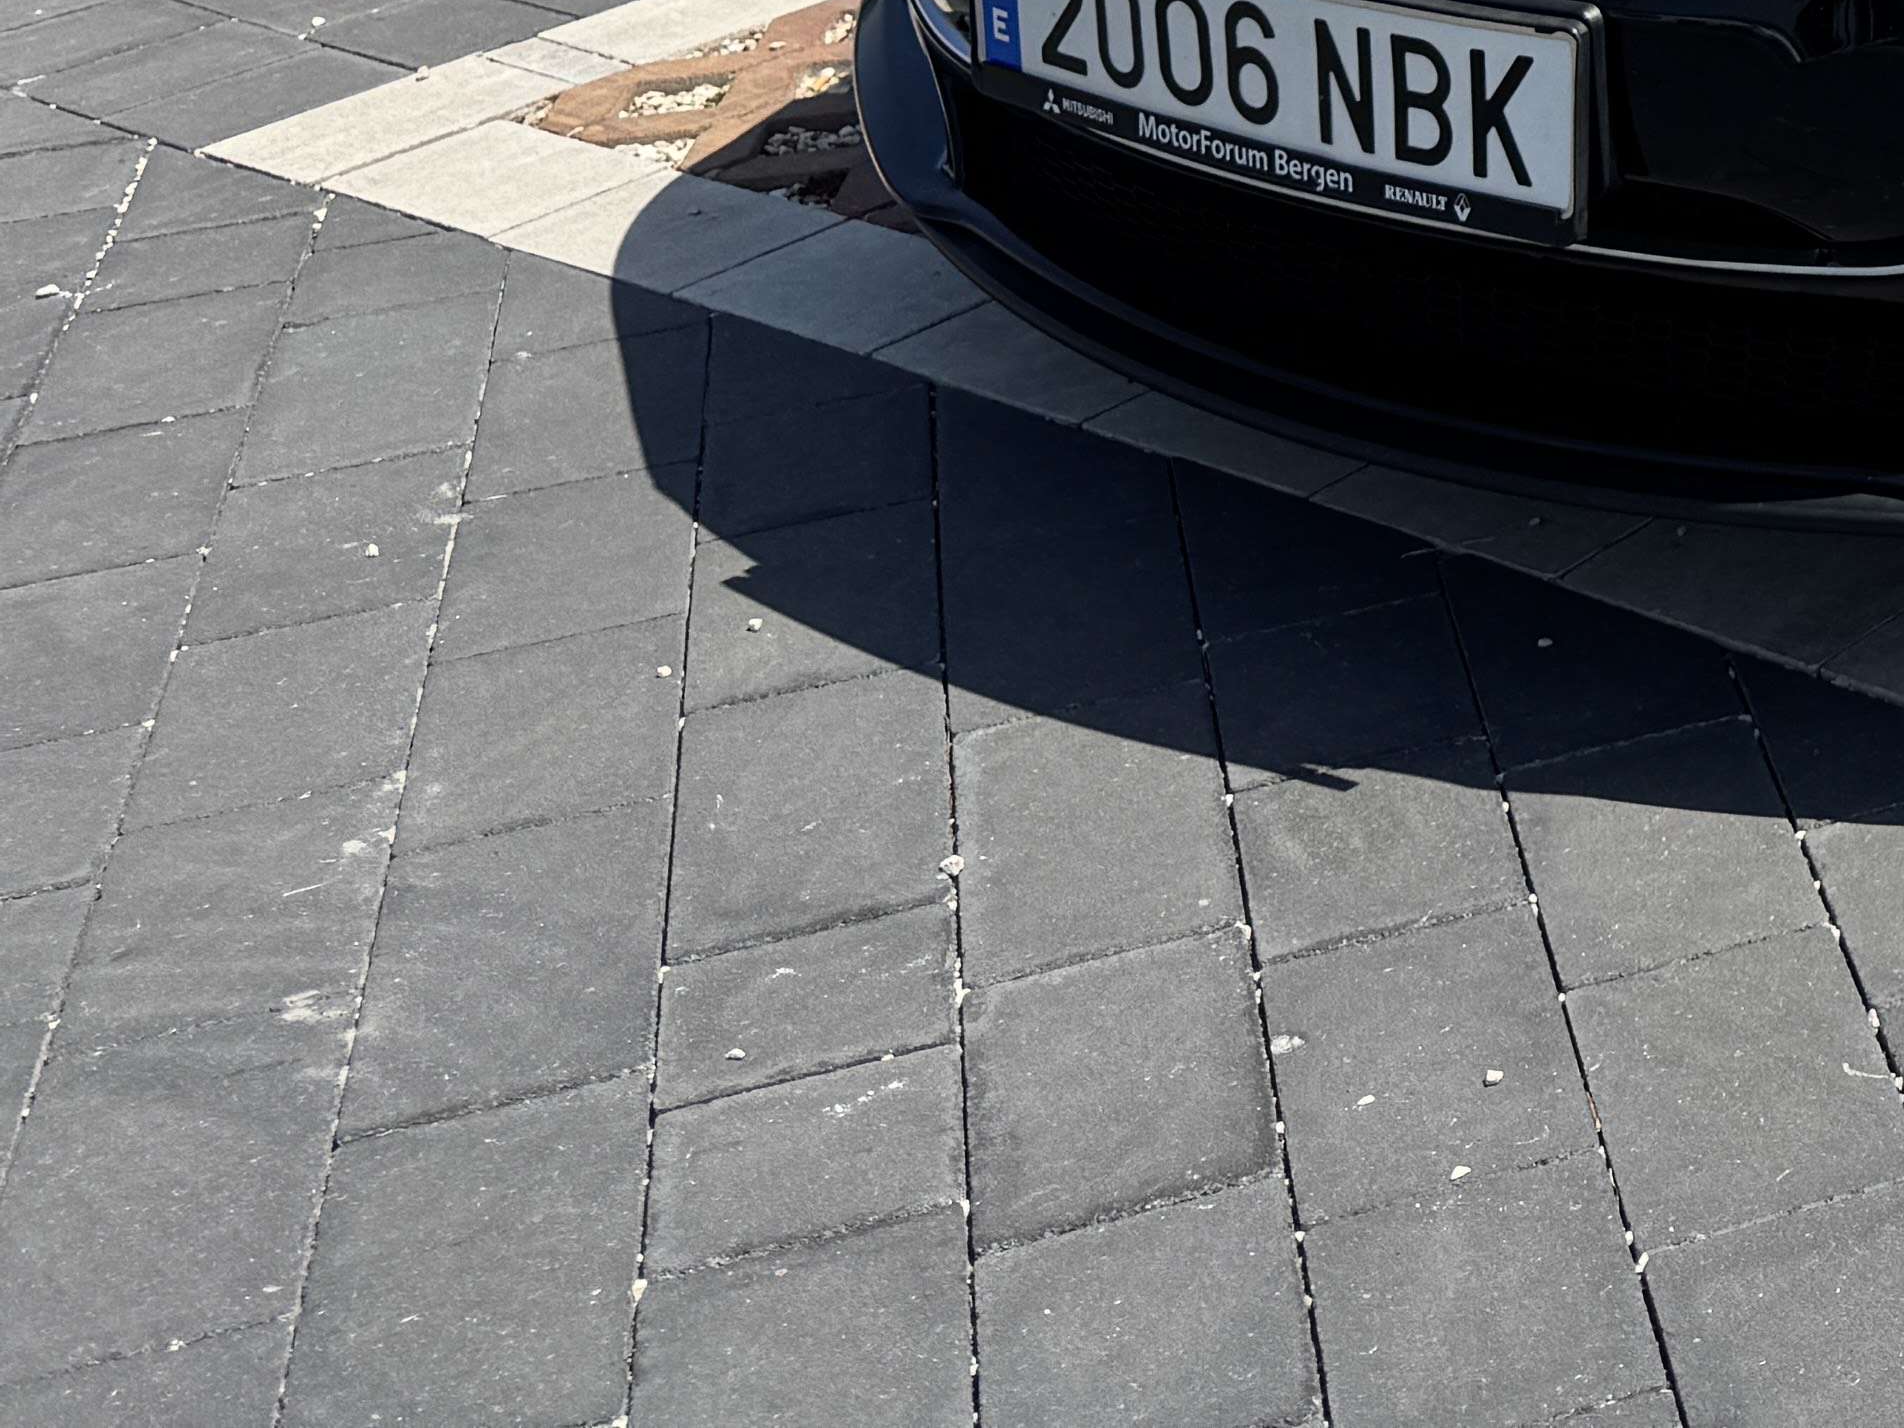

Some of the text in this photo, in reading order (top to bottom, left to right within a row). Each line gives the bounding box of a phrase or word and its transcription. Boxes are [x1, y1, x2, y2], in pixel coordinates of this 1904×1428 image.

[993, 6, 1010, 43] E
[1062, 97, 1114, 125] MITSUBISHI
[1314, 18, 1534, 188] NBK
[1138, 112, 1353, 192] MotorForum Bergen
[1385, 184, 1448, 211] RENAULT
